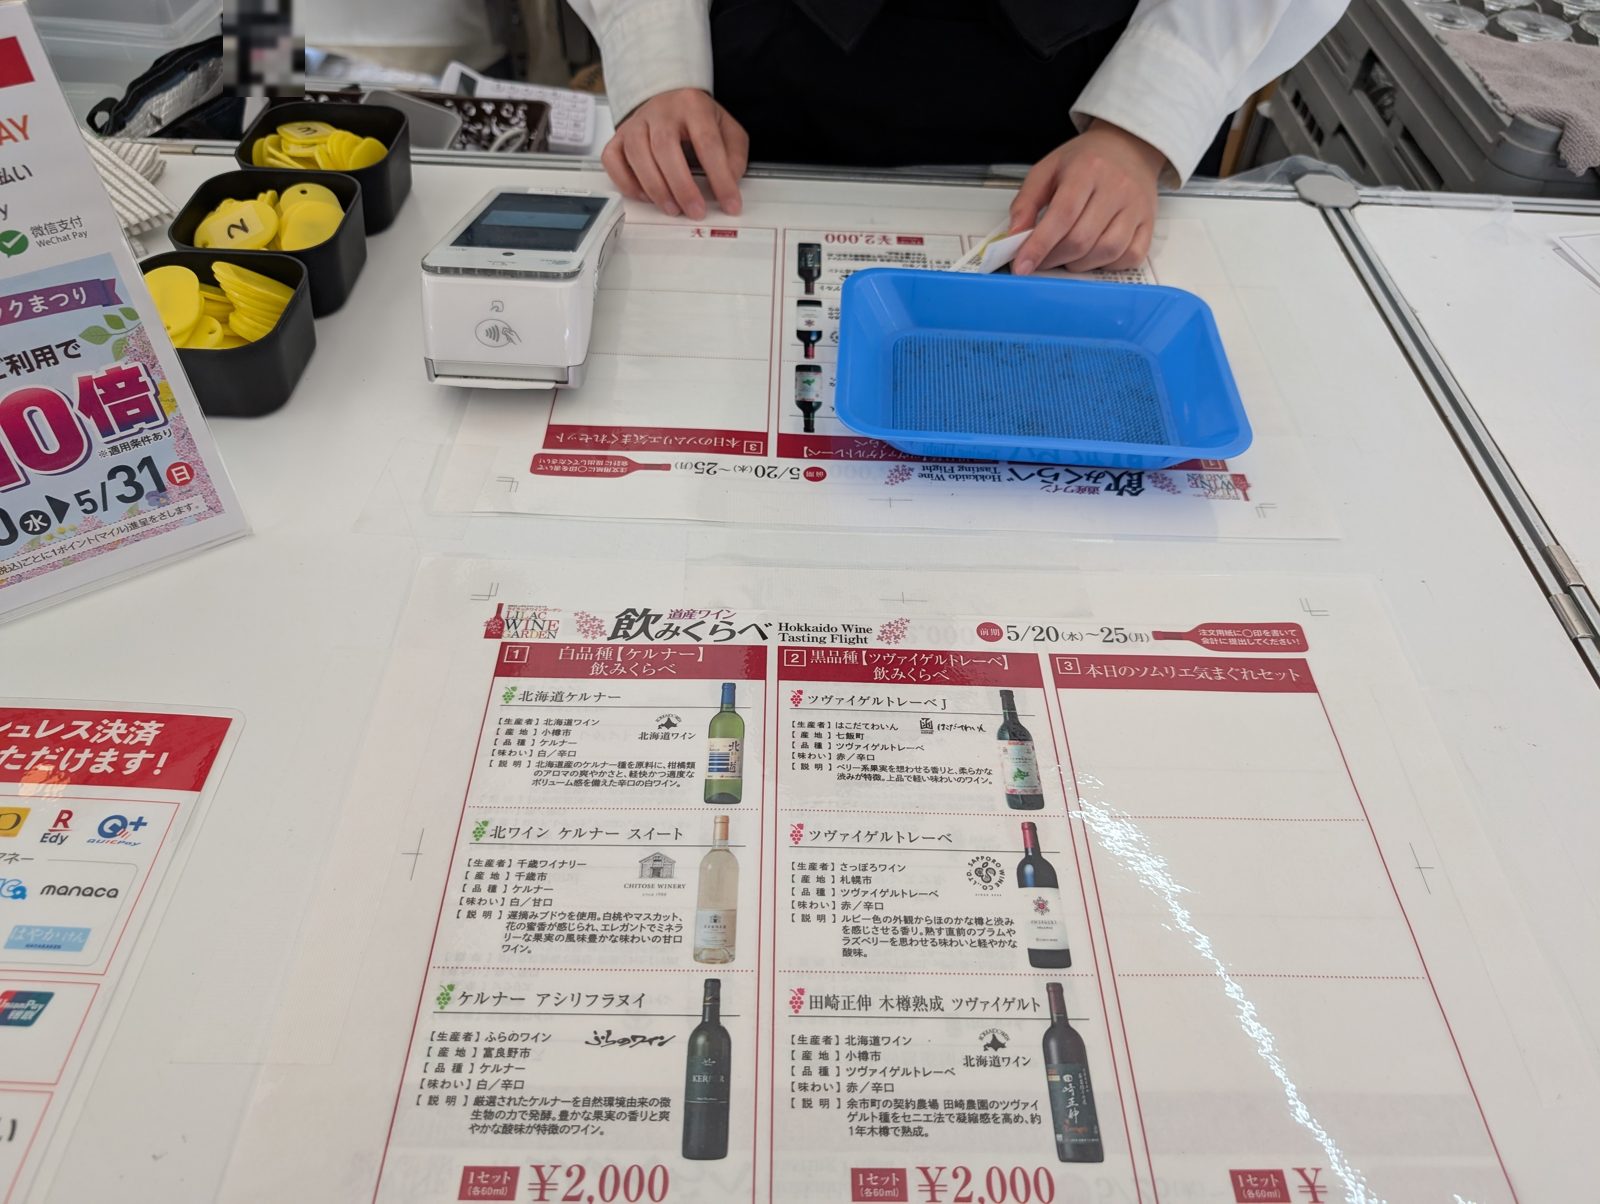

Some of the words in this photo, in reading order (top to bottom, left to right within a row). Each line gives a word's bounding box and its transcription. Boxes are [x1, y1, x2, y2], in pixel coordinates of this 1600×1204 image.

[30, 215, 83, 238] 微信支付
[227, 218, 250, 240] 2
[36, 234, 71, 248] WeChat
[72, 230, 88, 244] Pay
[0, 287, 87, 319] クまつり
[554, 432, 739, 450] 本日のソムリエ気まぐれセット
[748, 443, 758, 452] 3
[917, 472, 950, 481] Wine
[921, 464, 955, 474] Flight
[956, 465, 1000, 475] Tasting
[951, 473, 1002, 483] Hokkaido
[666, 609, 737, 621] 道産ワイン
[504, 618, 560, 632] WINE
[606, 607, 773, 643] 飲みくらべ
[778, 622, 839, 634] Hokkaido
[840, 624, 873, 635] Wine
[778, 632, 828, 646] Tasting
[830, 634, 869, 646] Flight
[558, 646, 706, 663] 白品種【ケルナー】
[809, 649, 1010, 670] 黒品種【ツヴァイゲルトレーベ】
[589, 662, 677, 677] 飲みくらべ
[873, 667, 951, 682] 飲みくらべ
[1085, 664, 1301, 682] 本日のソムリエ気まぐれセット
[517, 690, 622, 703] 北海道ケルナー
[637, 731, 697, 741] 北海道ワイン
[39, 832, 69, 846] Edy
[489, 825, 550, 840] 北ワイン
[558, 826, 620, 841] ケルナー
[627, 827, 684, 841] スイート
[809, 829, 954, 844] ツヴァイゲルトレーベ
[39, 884, 119, 899] manaca
[458, 991, 526, 1008] ケルナー
[536, 992, 647, 1009] アシリフラヌイ
[809, 994, 873, 1012] 田崎正伸
[879, 995, 945, 1013] 木樽熟成
[952, 996, 1042, 1013] ツヴァイゲルト
[962, 1055, 1032, 1068] 北海道ワイン
[467, 1171, 512, 1185] 1セット
[527, 1163, 670, 1204] ¥2,000
[858, 1172, 900, 1187] 1セット
[915, 1165, 1055, 1204] ¥2,000
[1237, 1174, 1280, 1188] 1セット
[1292, 1167, 1329, 1204] ¥
